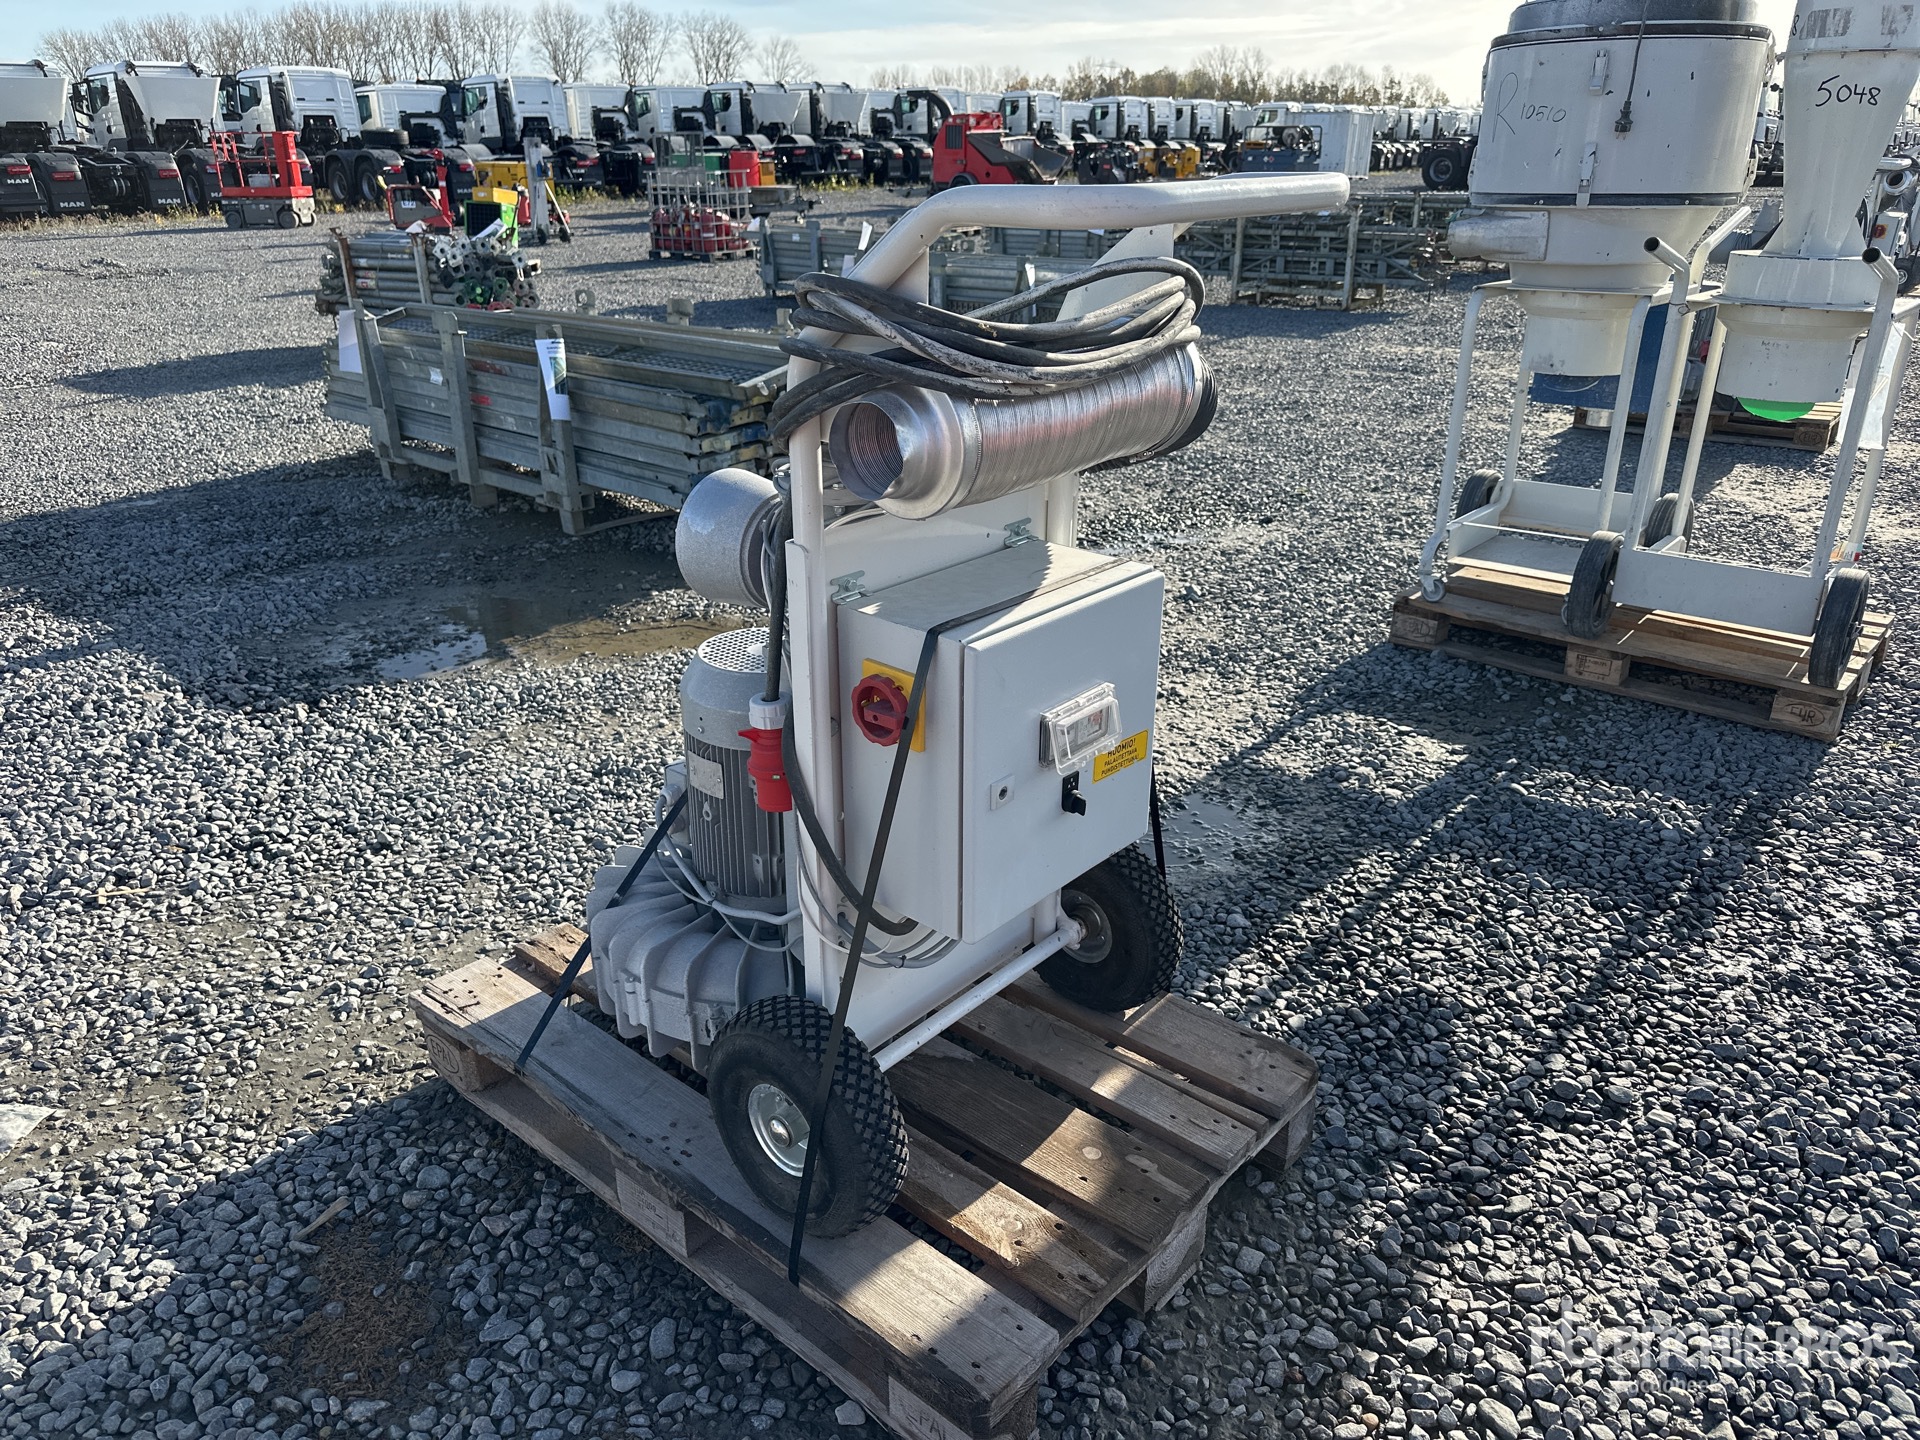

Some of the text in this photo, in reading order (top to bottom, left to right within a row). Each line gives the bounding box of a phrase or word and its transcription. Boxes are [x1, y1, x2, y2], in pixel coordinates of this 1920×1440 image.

[1815, 75, 1882, 107] 5048
[1492, 72, 1567, 143] R 10510
[1107, 737, 1136, 758] HUOMIO!
[430, 1037, 456, 1070] EPAL
